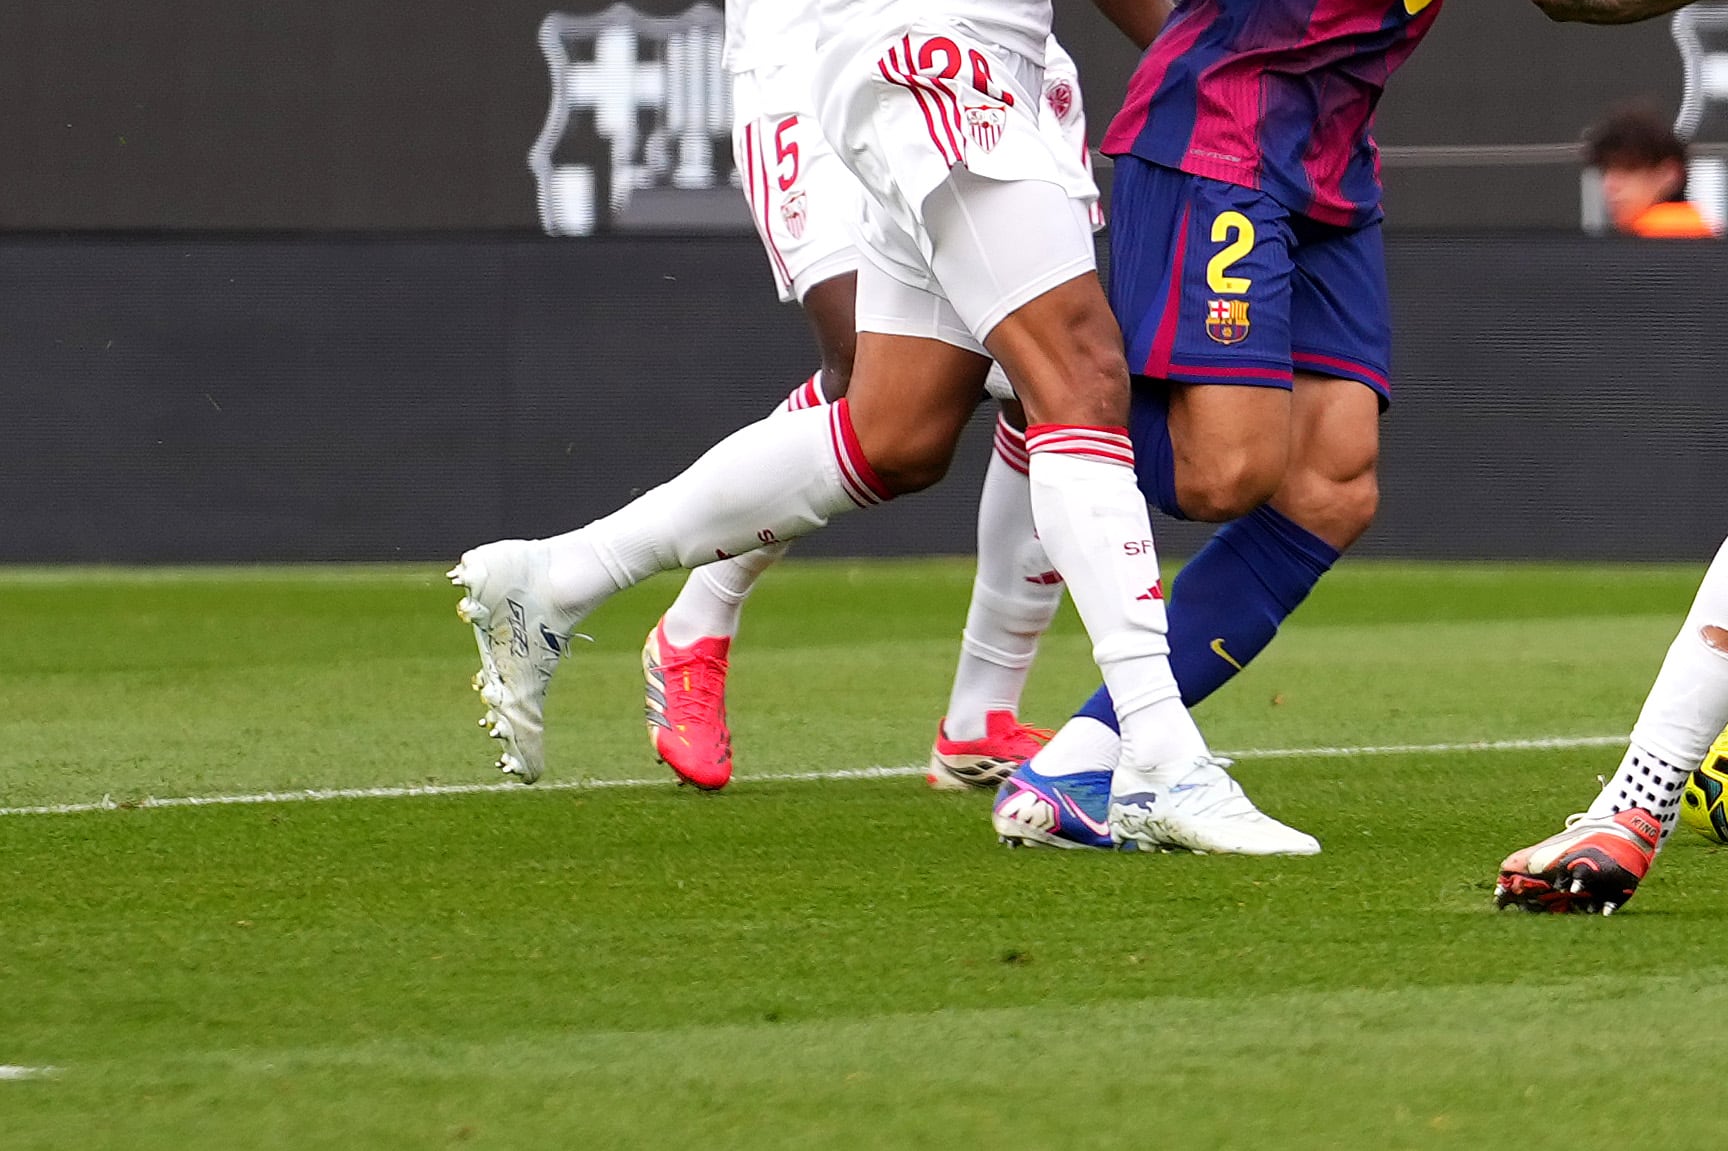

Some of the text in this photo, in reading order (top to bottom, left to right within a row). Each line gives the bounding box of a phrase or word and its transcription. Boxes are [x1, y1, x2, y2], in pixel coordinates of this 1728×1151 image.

[774, 114, 800, 192] 5
[1205, 210, 1256, 295] 2
[1123, 539, 1153, 556] SF
[1630, 816, 1658, 838] KING
